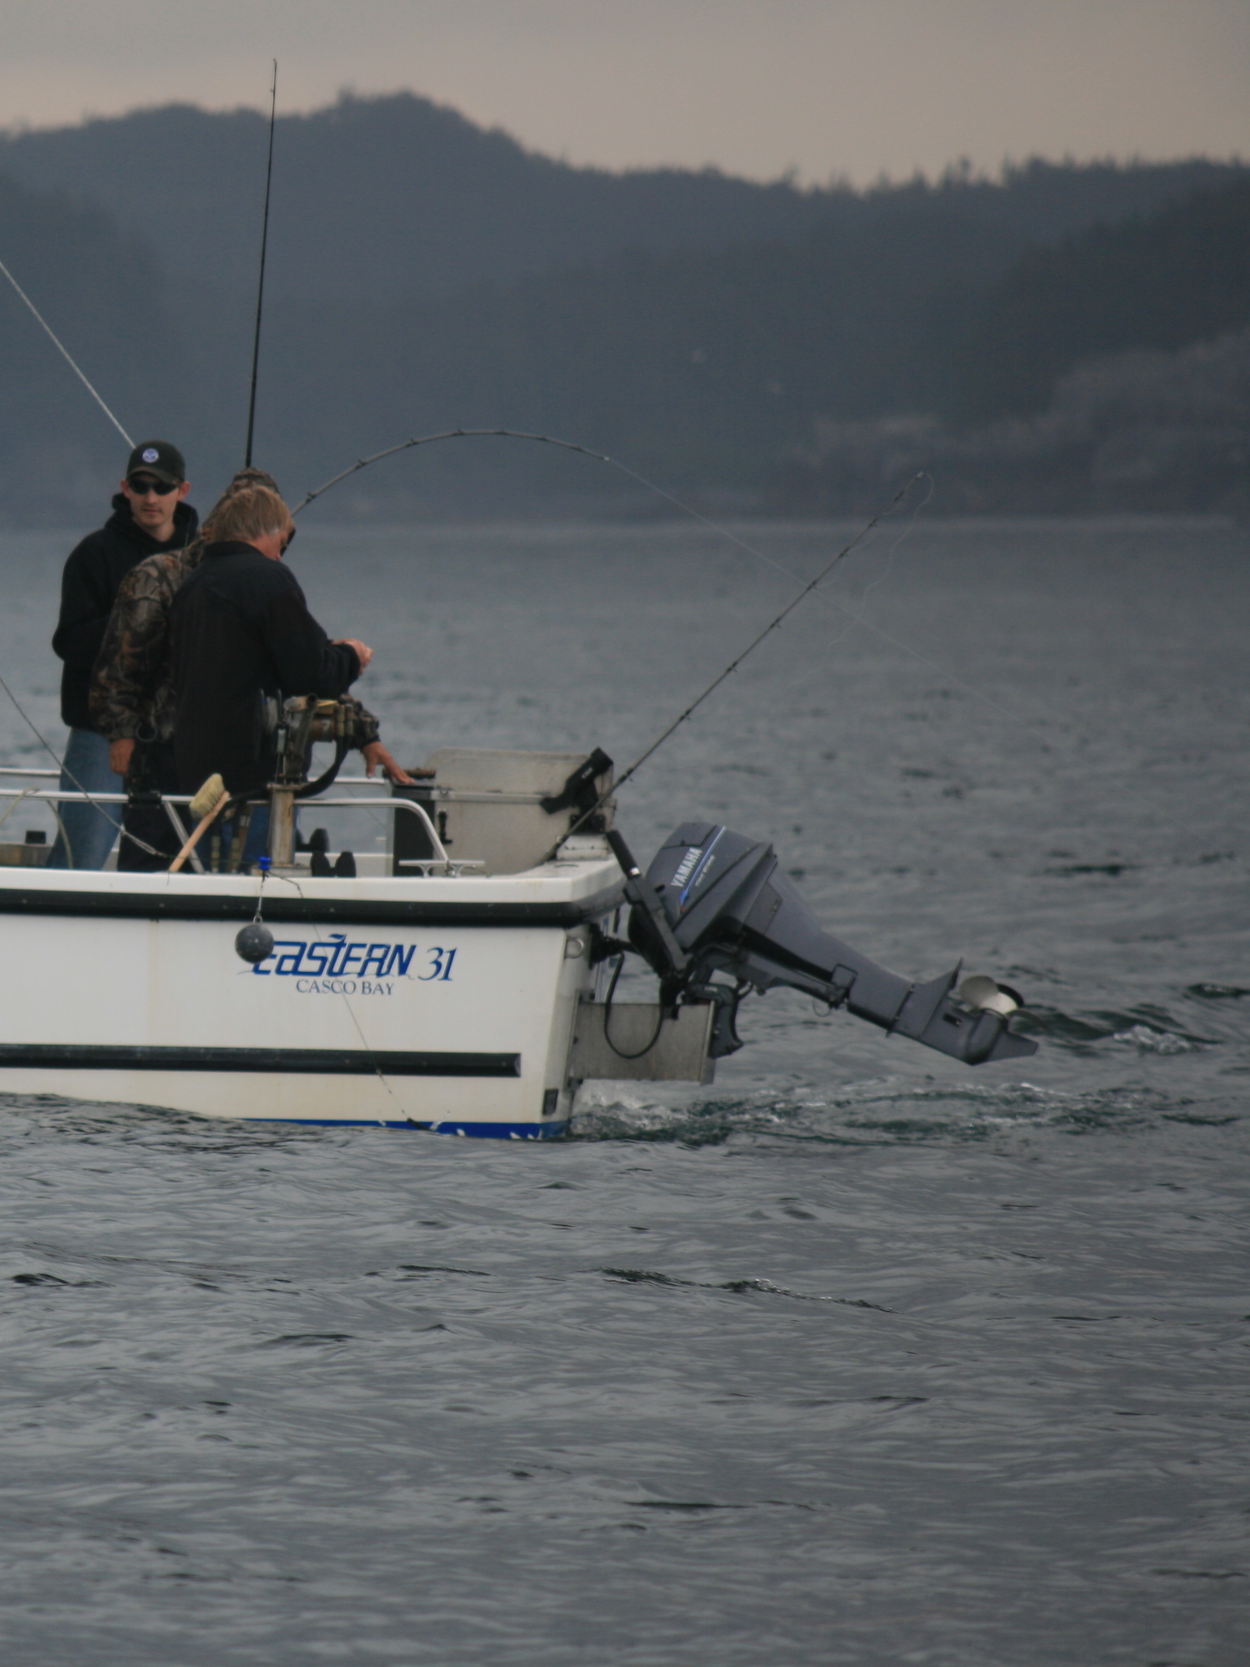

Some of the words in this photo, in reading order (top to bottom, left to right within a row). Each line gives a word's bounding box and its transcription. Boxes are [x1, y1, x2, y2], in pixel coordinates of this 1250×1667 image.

[670, 846, 703, 888] YAMAHA
[417, 946, 458, 982] 31
[296, 979, 357, 995] CASCO
[361, 980, 395, 996] BAY
